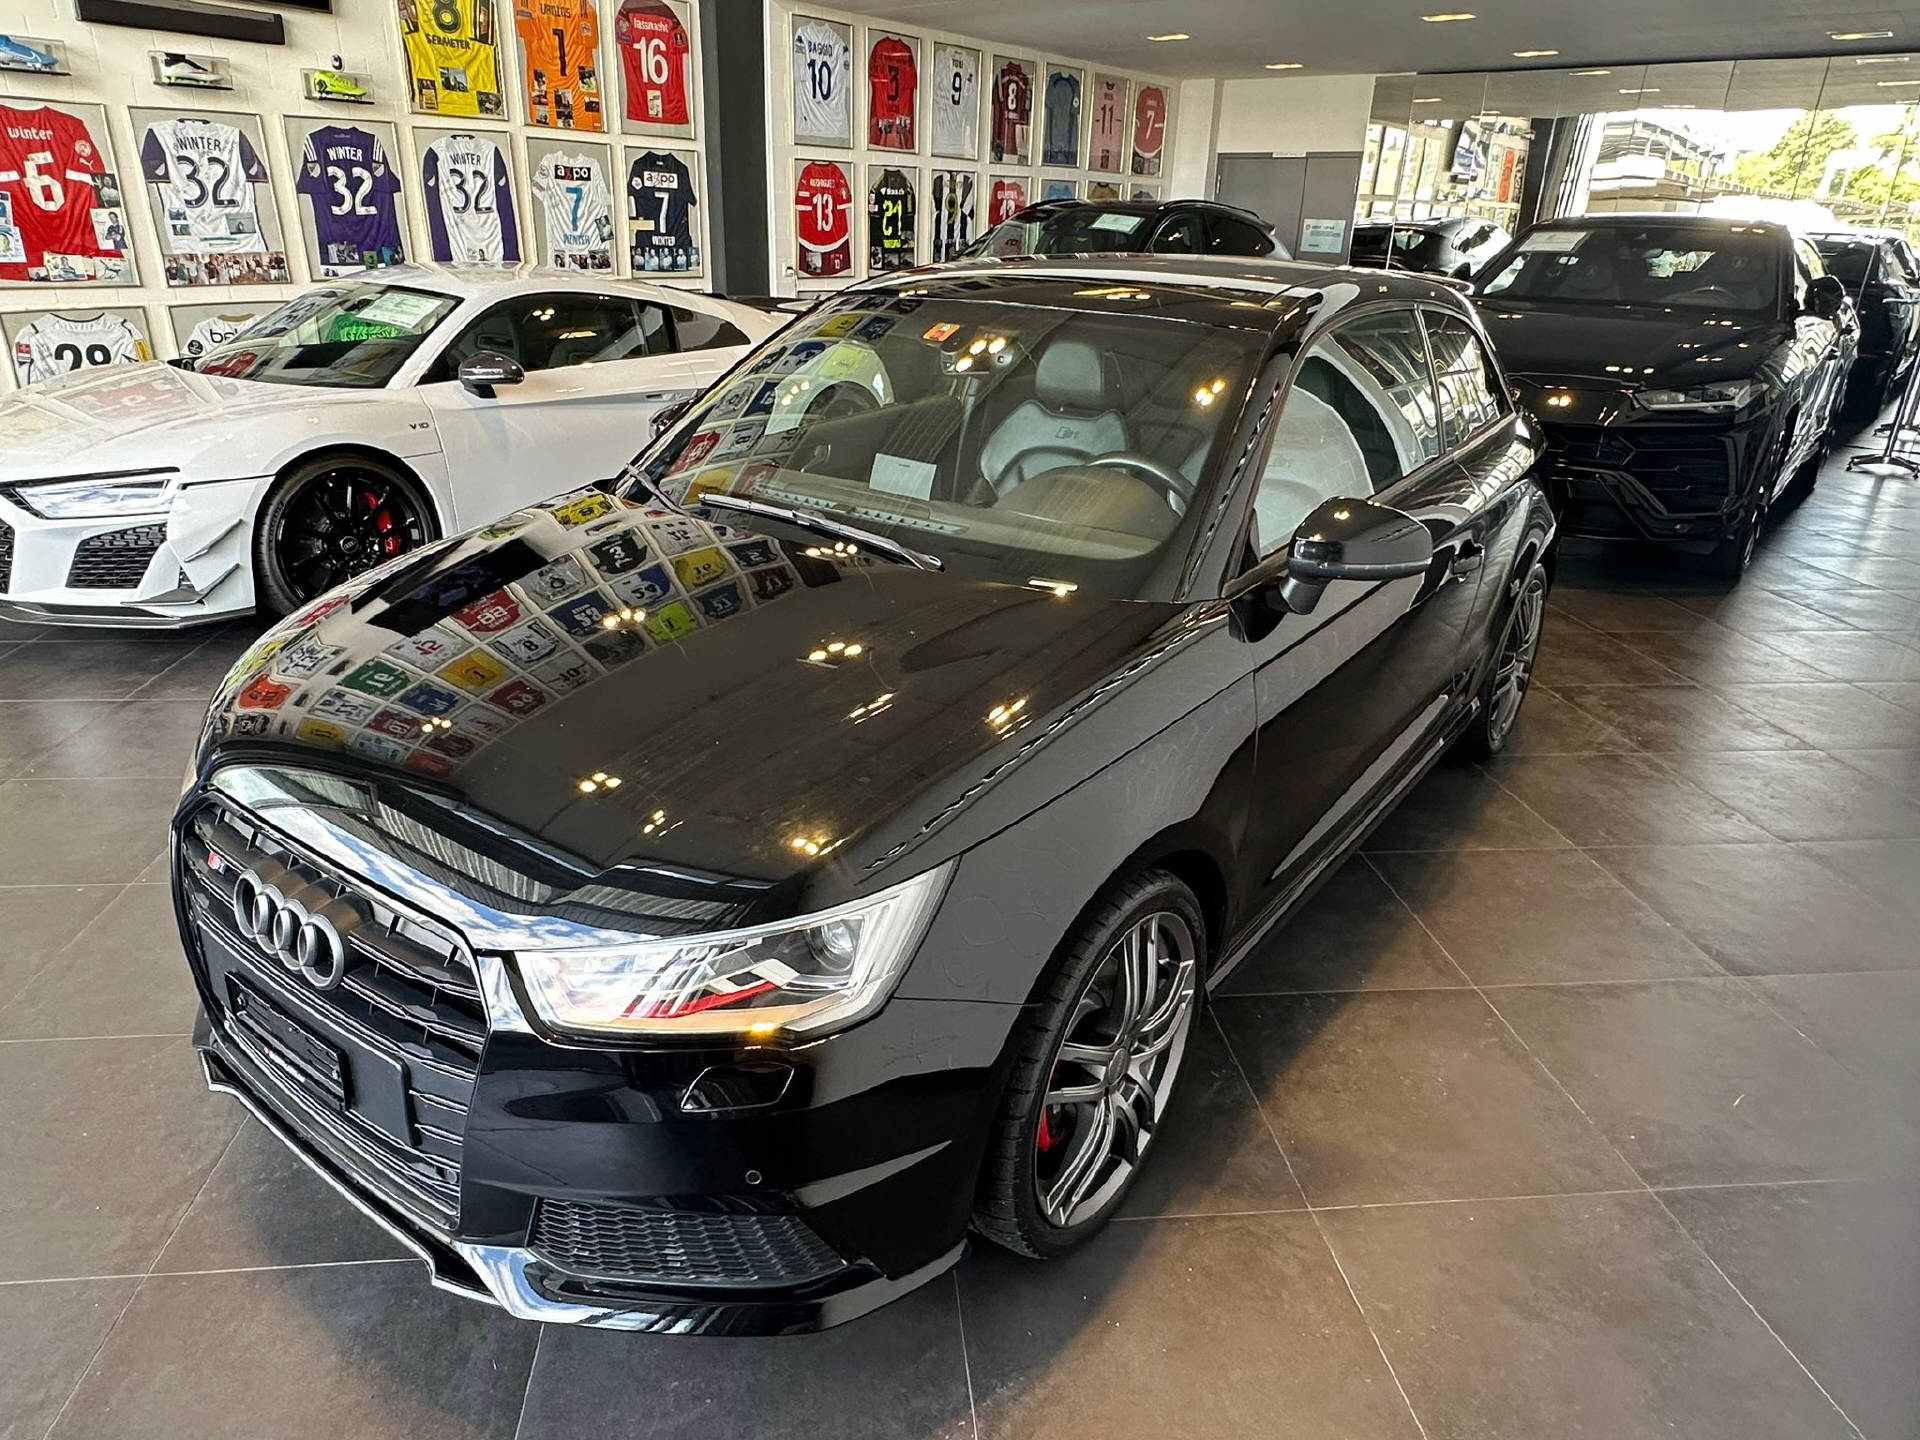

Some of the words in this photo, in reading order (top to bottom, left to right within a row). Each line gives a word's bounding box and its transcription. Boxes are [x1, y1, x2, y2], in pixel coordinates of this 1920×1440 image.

[433, 0, 461, 34] 8
[552, 28, 567, 76] 1
[632, 36, 669, 85] 16
[807, 59, 831, 100] 10
[951, 72, 962, 105] 9
[1008, 82, 1017, 111] 8
[7, 126, 53, 140] winter
[1101, 104, 1113, 135] 11
[176, 136, 221, 152] WINTER
[326, 146, 363, 161] WINTER
[450, 152, 481, 165] WINTER
[23, 151, 65, 212] 6
[176, 155, 240, 208] 32
[326, 165, 377, 215] 32
[449, 168, 494, 214] 32
[566, 186, 582, 232] 7
[654, 192, 669, 234] 7
[812, 193, 834, 232] 13
[883, 200, 902, 236] 21
[945, 193, 958, 224] 9
